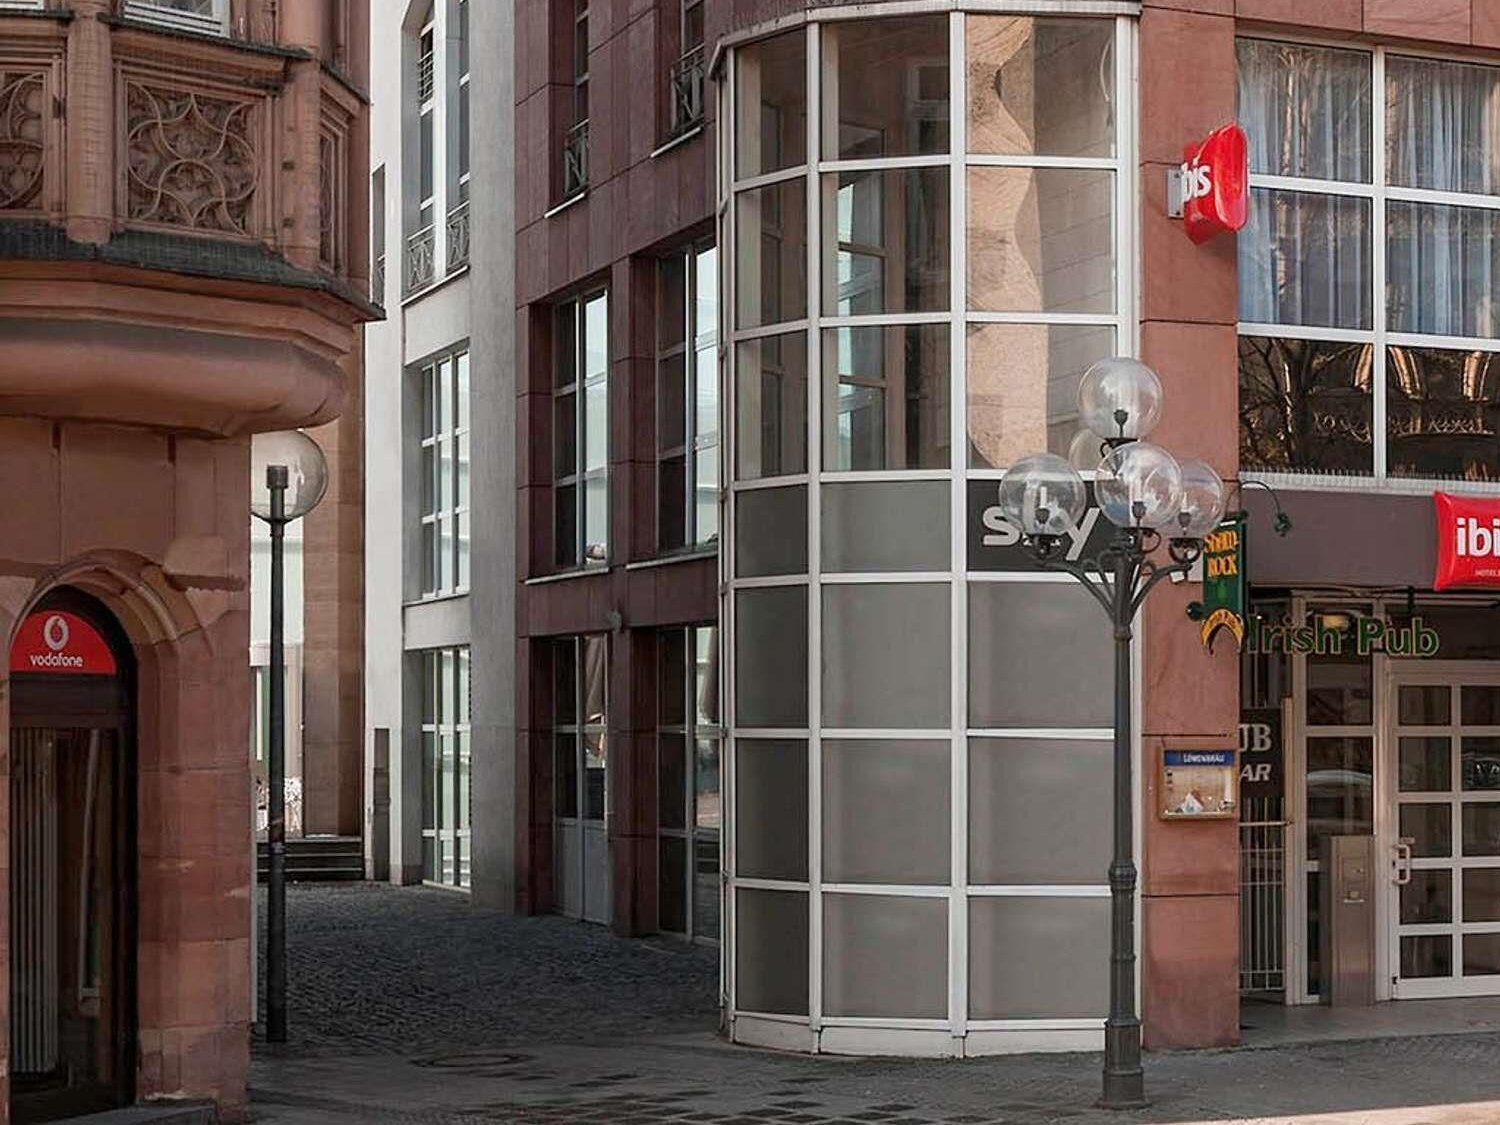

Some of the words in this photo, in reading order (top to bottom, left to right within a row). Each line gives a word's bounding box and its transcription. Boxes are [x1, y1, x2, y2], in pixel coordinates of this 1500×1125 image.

[1248, 613, 1342, 655] Irish
[1356, 616, 1440, 656] Pub
[30, 651, 83, 668] vodafone
[1240, 763, 1272, 782] AR
